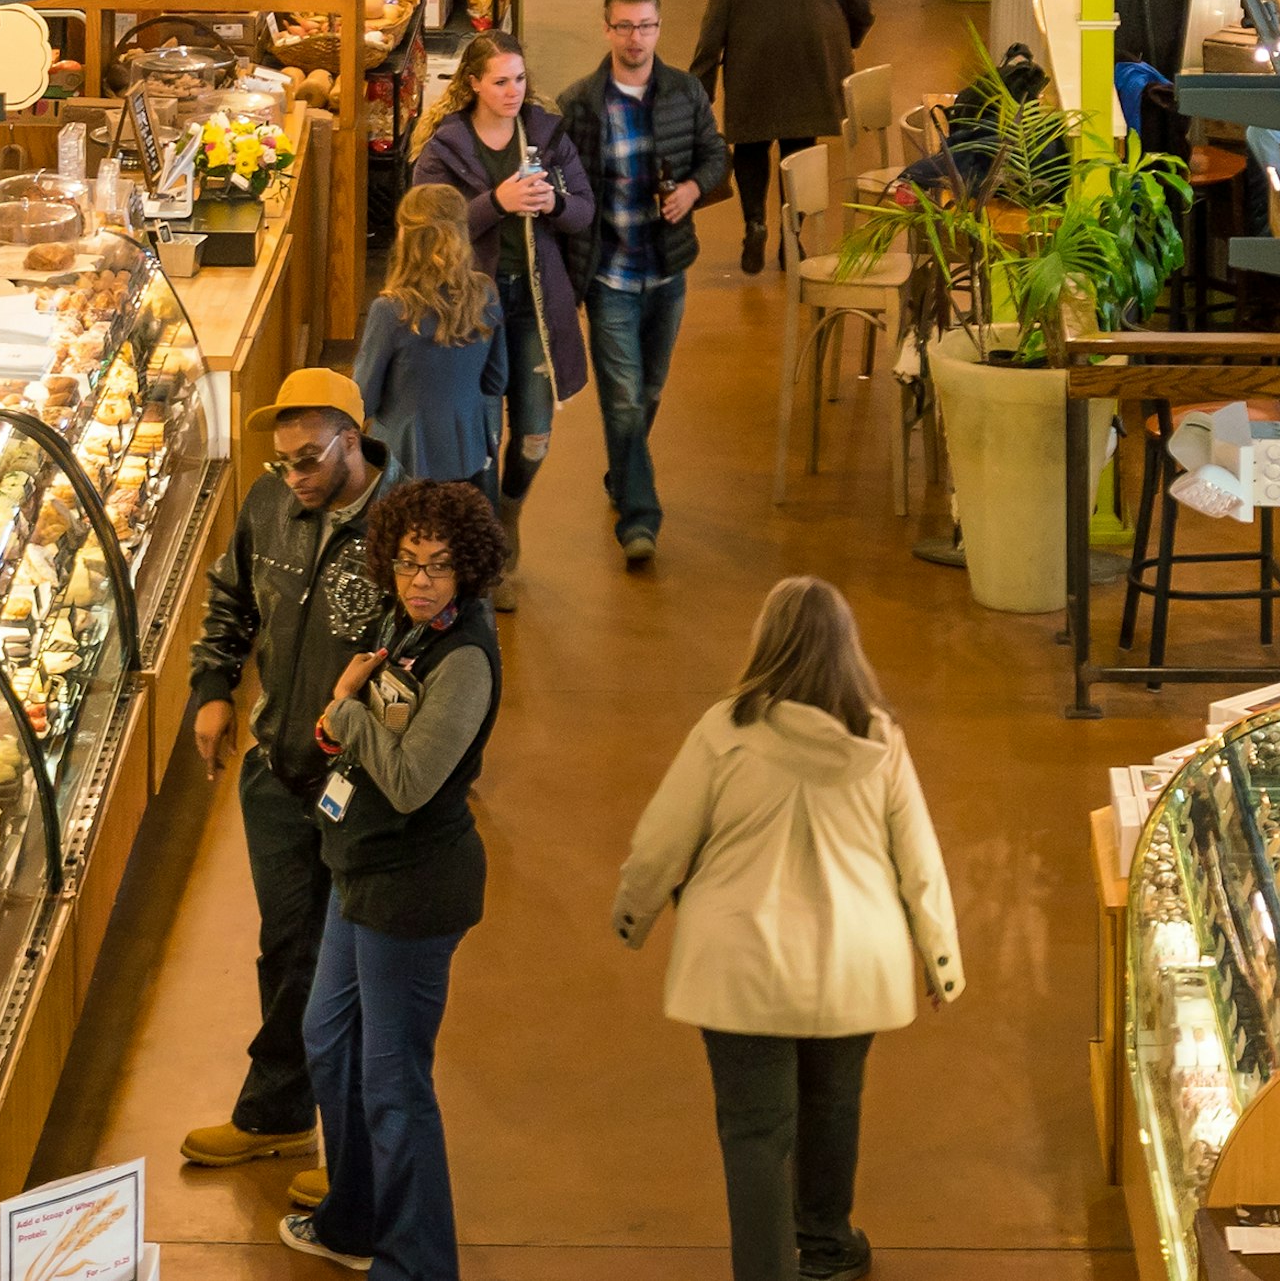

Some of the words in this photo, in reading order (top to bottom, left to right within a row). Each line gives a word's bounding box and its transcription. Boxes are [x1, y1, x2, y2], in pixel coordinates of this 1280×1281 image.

[17, 1219, 33, 1229] Add
[42, 1212, 65, 1223] Scoop
[65, 1207, 74, 1215] of
[74, 1200, 97, 1211] Whey
[18, 1229, 48, 1243] Protein
[86, 1269, 98, 1278] For
